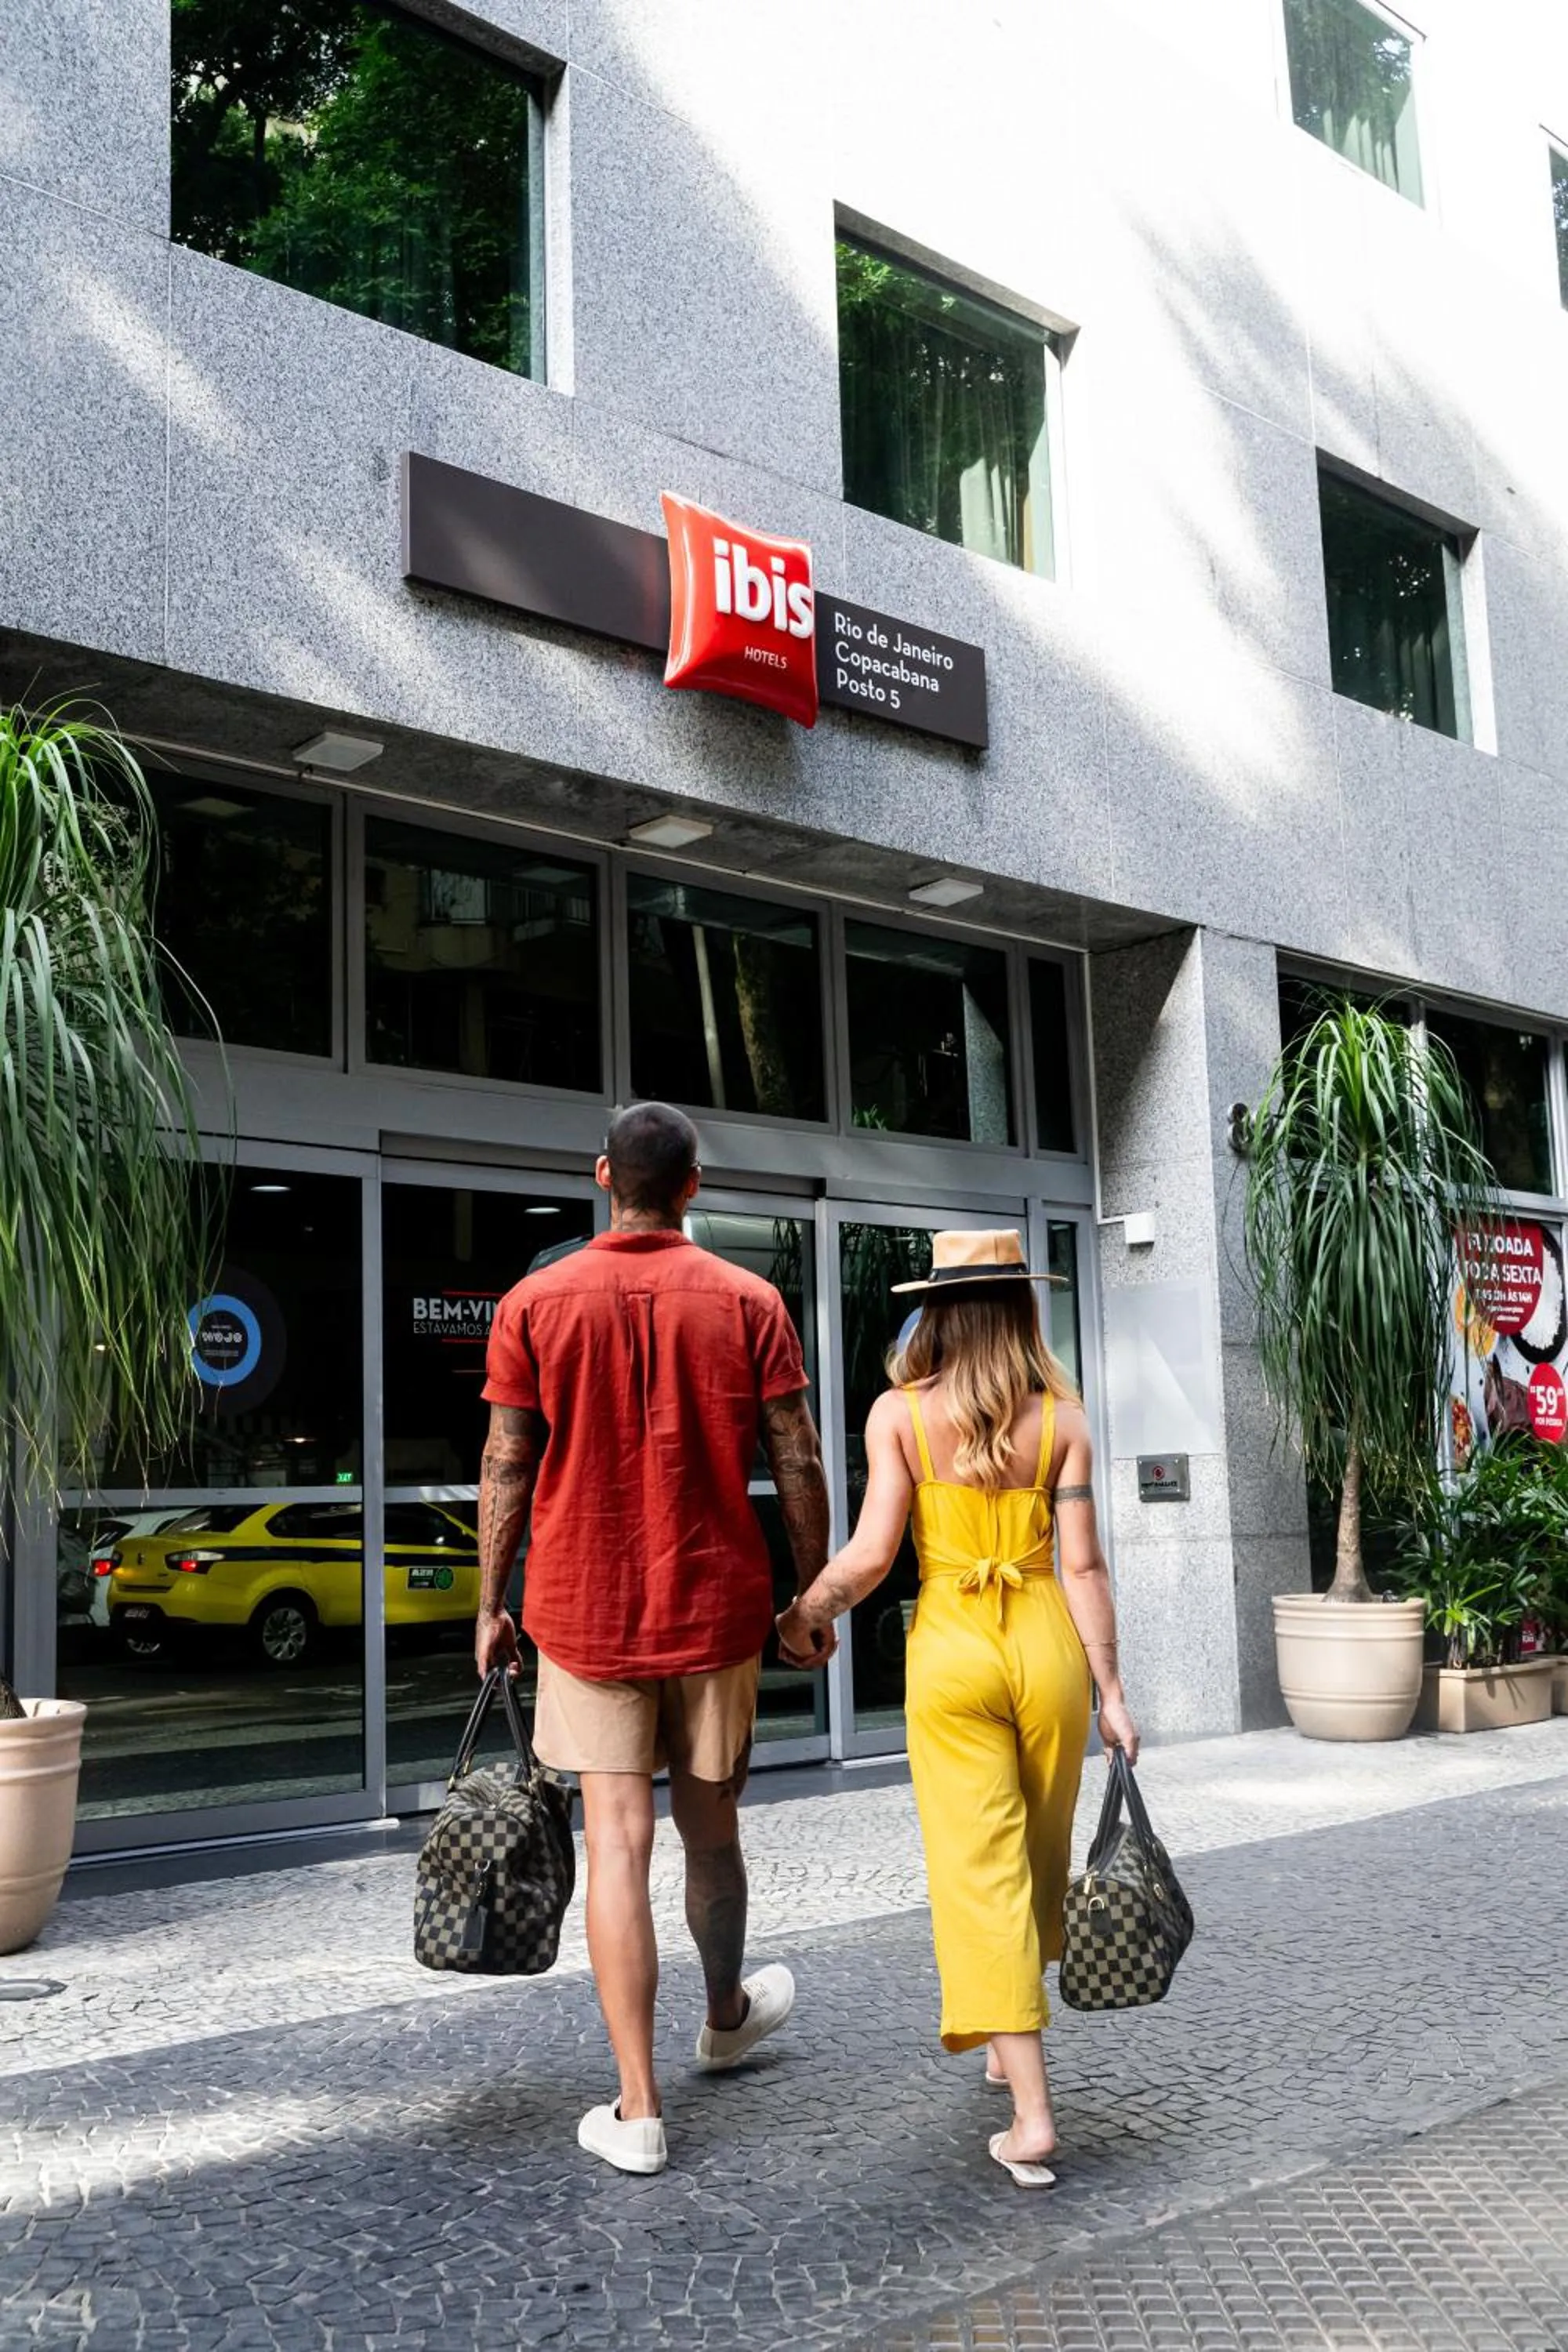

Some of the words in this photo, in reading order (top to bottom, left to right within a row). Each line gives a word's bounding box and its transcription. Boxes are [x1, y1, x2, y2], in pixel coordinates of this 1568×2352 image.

[713, 536, 813, 639] ibis
[745, 645, 787, 669] HOTELS
[834, 612, 862, 640] Rio
[866, 623, 888, 648] de
[893, 633, 954, 670] Janeiro
[835, 641, 939, 692] Copacabana
[837, 668, 885, 702] Posto
[890, 689, 901, 709] 5
[1467, 1232, 1534, 1257] FIOADA
[1502, 1264, 1543, 1286] SEXTA
[1536, 1385, 1558, 1415] 59
